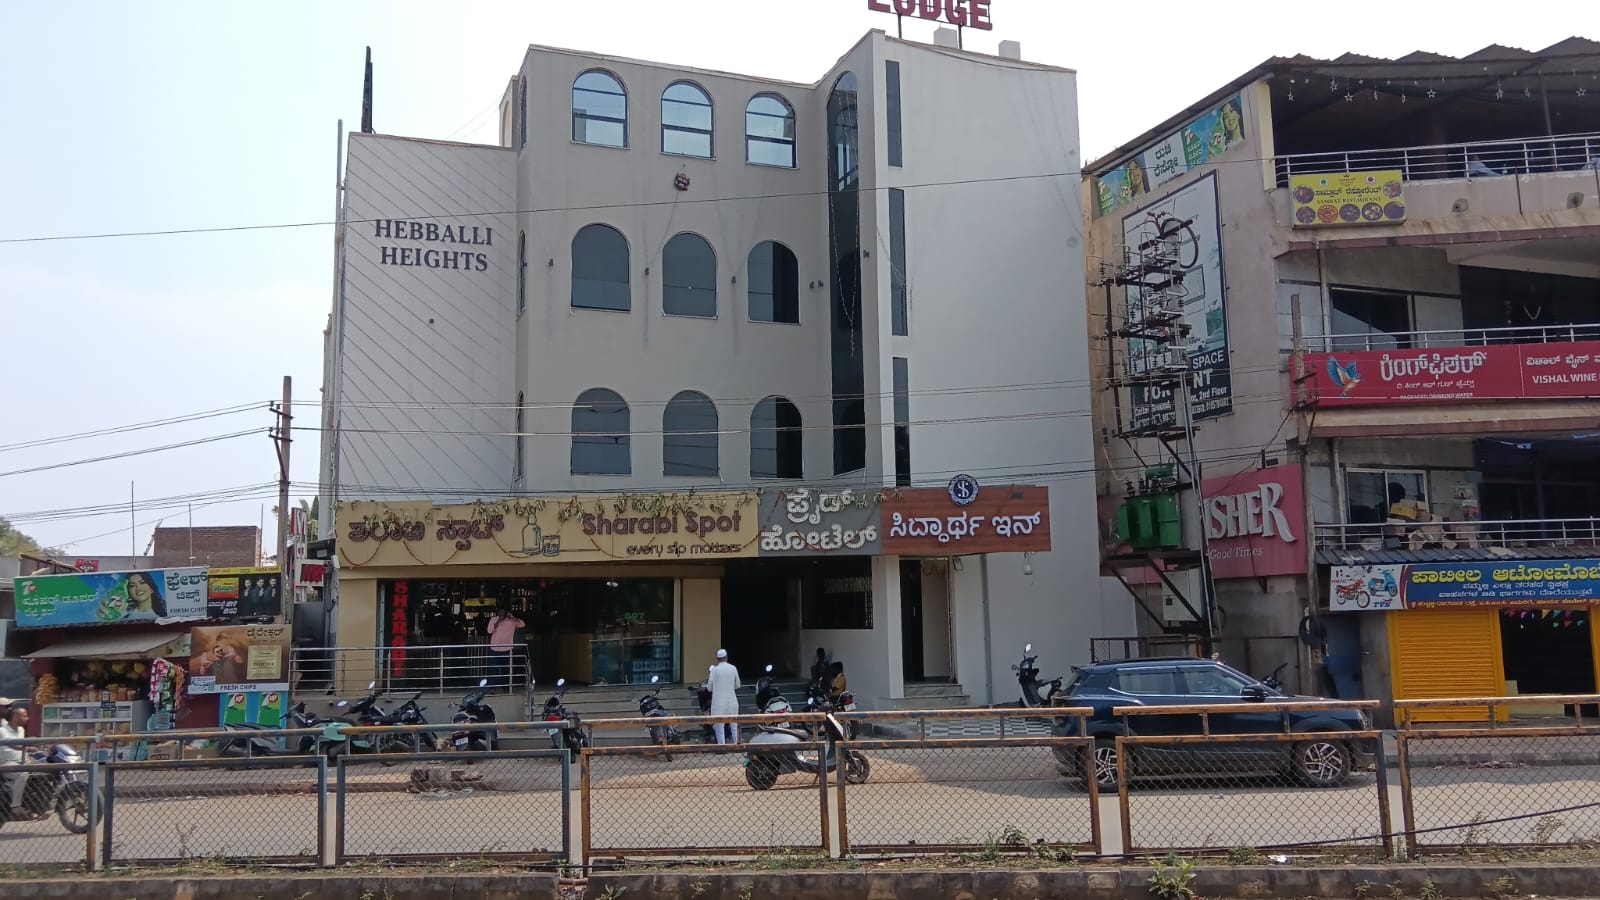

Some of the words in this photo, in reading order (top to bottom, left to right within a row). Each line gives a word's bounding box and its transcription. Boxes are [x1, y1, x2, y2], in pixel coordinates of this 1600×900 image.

[375, 218, 493, 246] HEBBALLI
[380, 246, 488, 272] HEIGHTS
[1192, 350, 1225, 370] SPACE
[1532, 374, 1569, 384] VISHAL
[1570, 372, 1598, 382] WINE
[1211, 386, 1228, 398] Floor
[582, 509, 678, 536] Sharabi
[684, 509, 742, 538] Spot
[991, 511, 1041, 538] ಇನ್
[626, 542, 664, 558] every
[666, 541, 687, 557] sip
[760, 524, 878, 551] ಹೋಟೆಲ್
